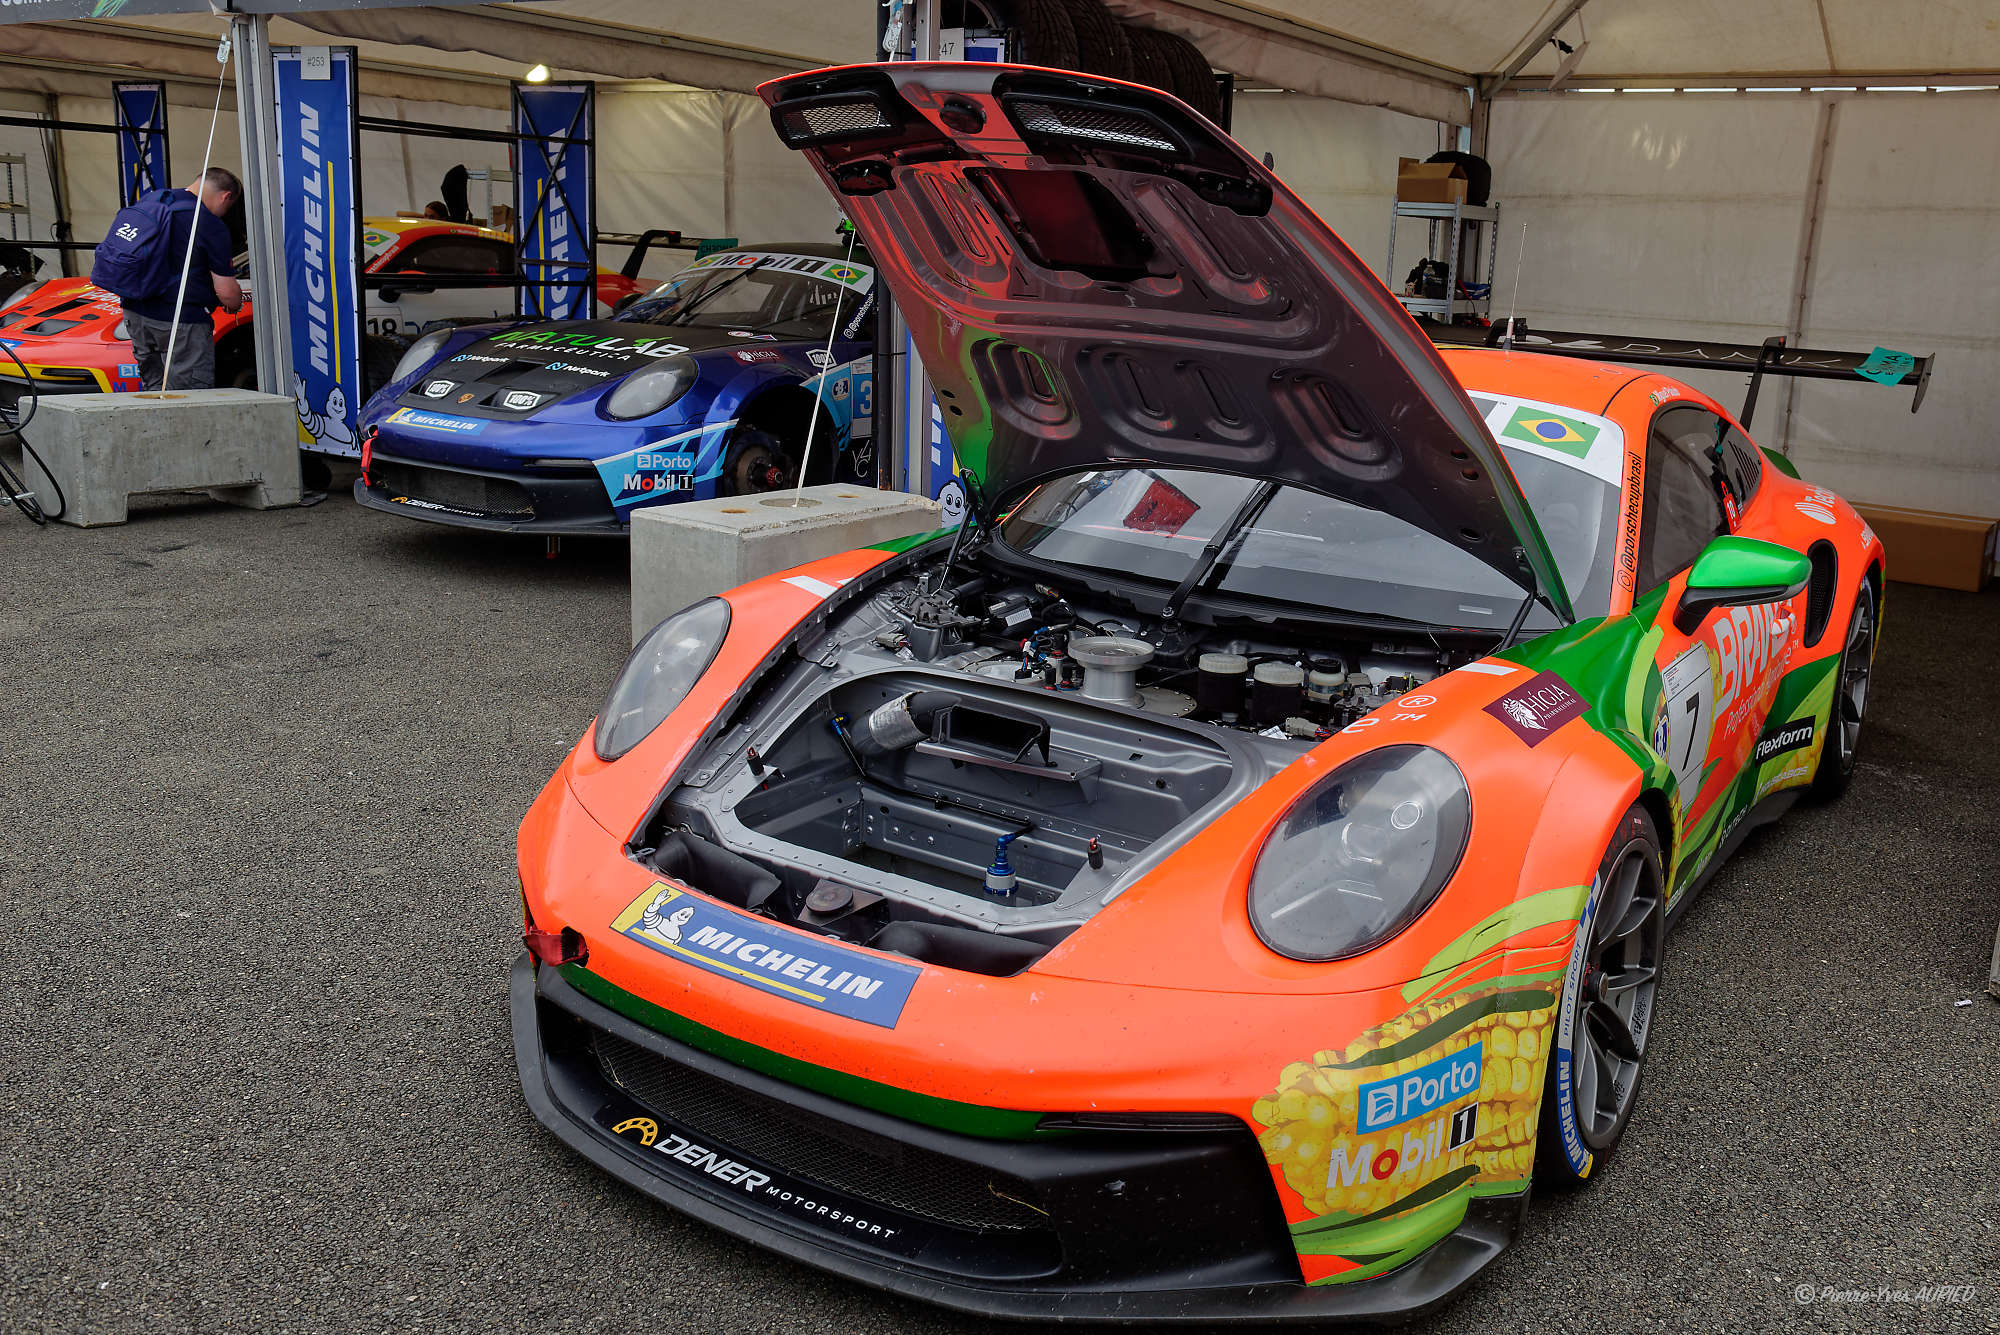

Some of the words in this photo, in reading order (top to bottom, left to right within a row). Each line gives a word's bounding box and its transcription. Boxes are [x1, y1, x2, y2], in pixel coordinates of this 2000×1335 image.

[307, 56, 325, 67] #253
[299, 101, 329, 376] MICHELIN
[548, 127, 569, 320] ICHELIN
[713, 254, 798, 269] Mobil
[368, 317, 397, 336] 18
[489, 331, 690, 358] NATULAB
[428, 383, 451, 394] 100%
[562, 364, 612, 378] Netpark
[508, 393, 536, 406] 100%
[413, 416, 478, 430] MICHELIN
[650, 454, 692, 469] Porto
[623, 473, 676, 491] Mobil
[1620, 451, 1642, 573] @porschecupbrasil
[1686, 691, 1700, 772] 7
[1755, 725, 1813, 760] Flexform
[687, 925, 884, 1000] MICHELIN
[1563, 999, 1573, 1037] PILOT
[1570, 942, 1582, 990] SPORT
[1402, 1058, 1477, 1117] Porto
[1560, 1061, 1583, 1165] MICHELIN
[1327, 1116, 1443, 1189] Mobil
[653, 1133, 771, 1192] DENER
[765, 1185, 895, 1239] MOTORSPORT
